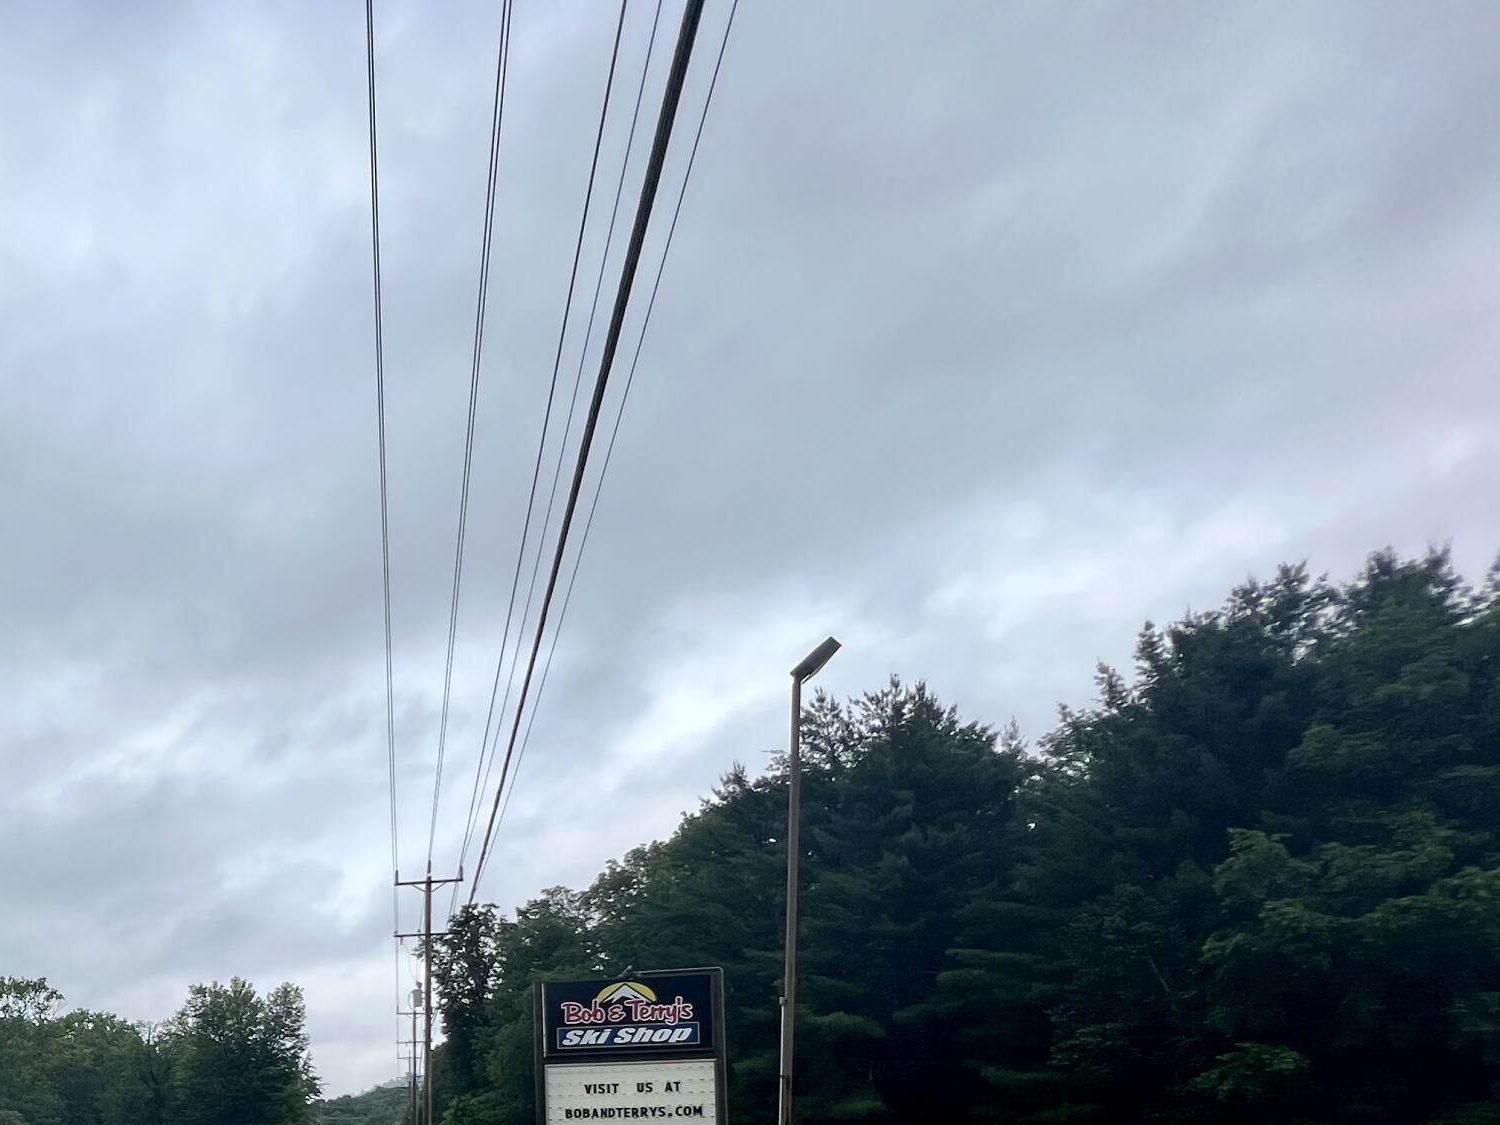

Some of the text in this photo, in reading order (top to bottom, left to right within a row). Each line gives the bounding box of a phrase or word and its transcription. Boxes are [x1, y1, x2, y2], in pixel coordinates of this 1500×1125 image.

[561, 996, 693, 1024] Bob & Terry's
[562, 1027, 693, 1045] Ski Shop
[584, 1081, 681, 1094] VISIT US AT
[565, 1106, 703, 1119] BOBANDTERRYS.COM
